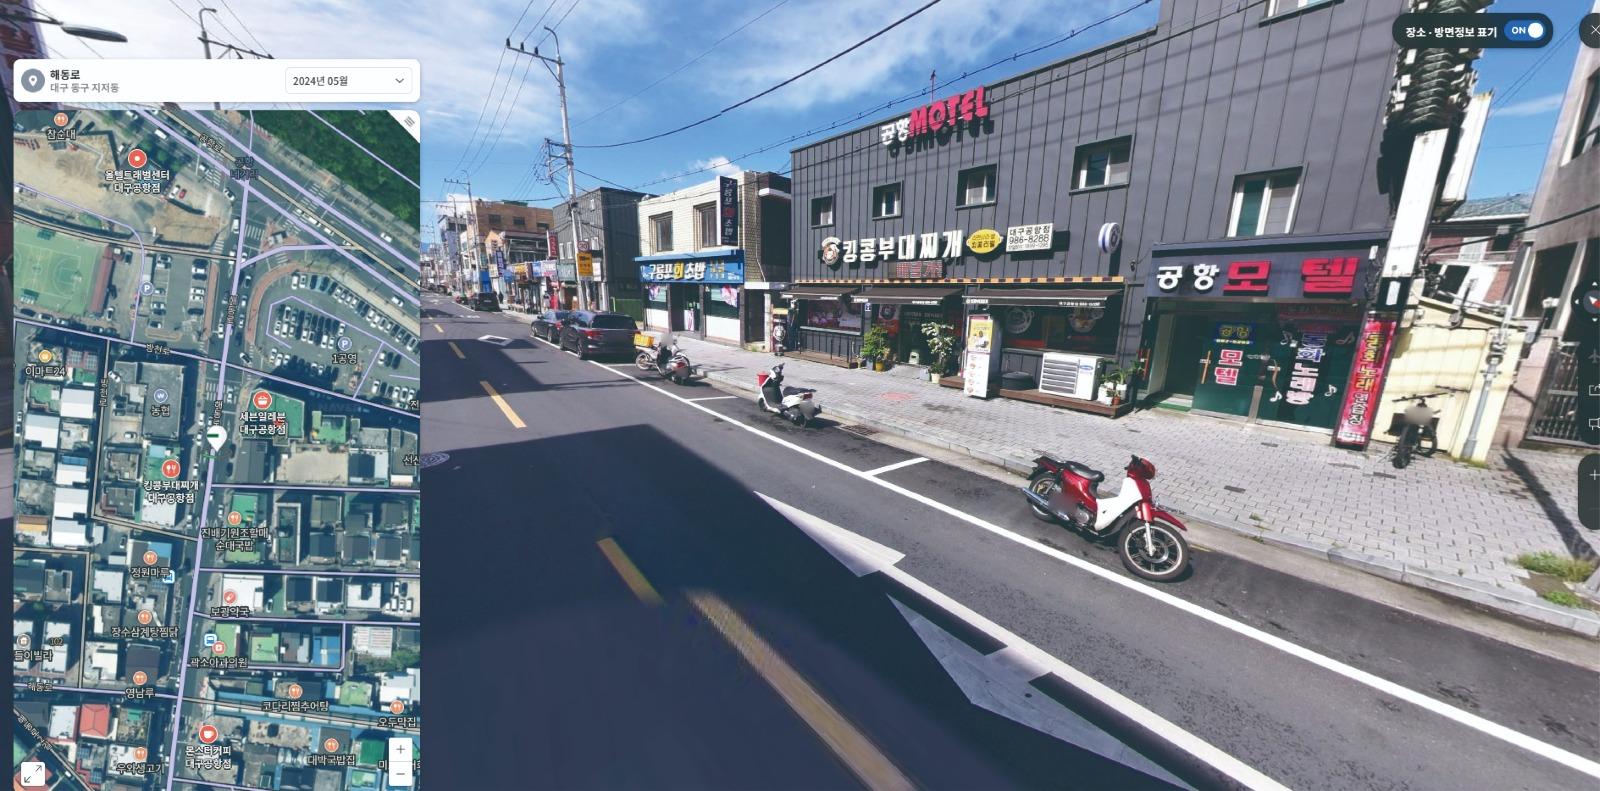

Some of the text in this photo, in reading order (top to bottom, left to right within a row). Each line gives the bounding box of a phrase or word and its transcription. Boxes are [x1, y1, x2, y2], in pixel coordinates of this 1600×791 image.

[881, 85, 988, 146] 공항 MOTEL
[842, 230, 963, 263] 킹콩부대찌개
[1009, 226, 1050, 236] 대구공항점
[1009, 234, 1049, 244] 986-8288
[1156, 256, 1361, 294] 공항 모텔
[1215, 349, 1243, 386] 모텔
